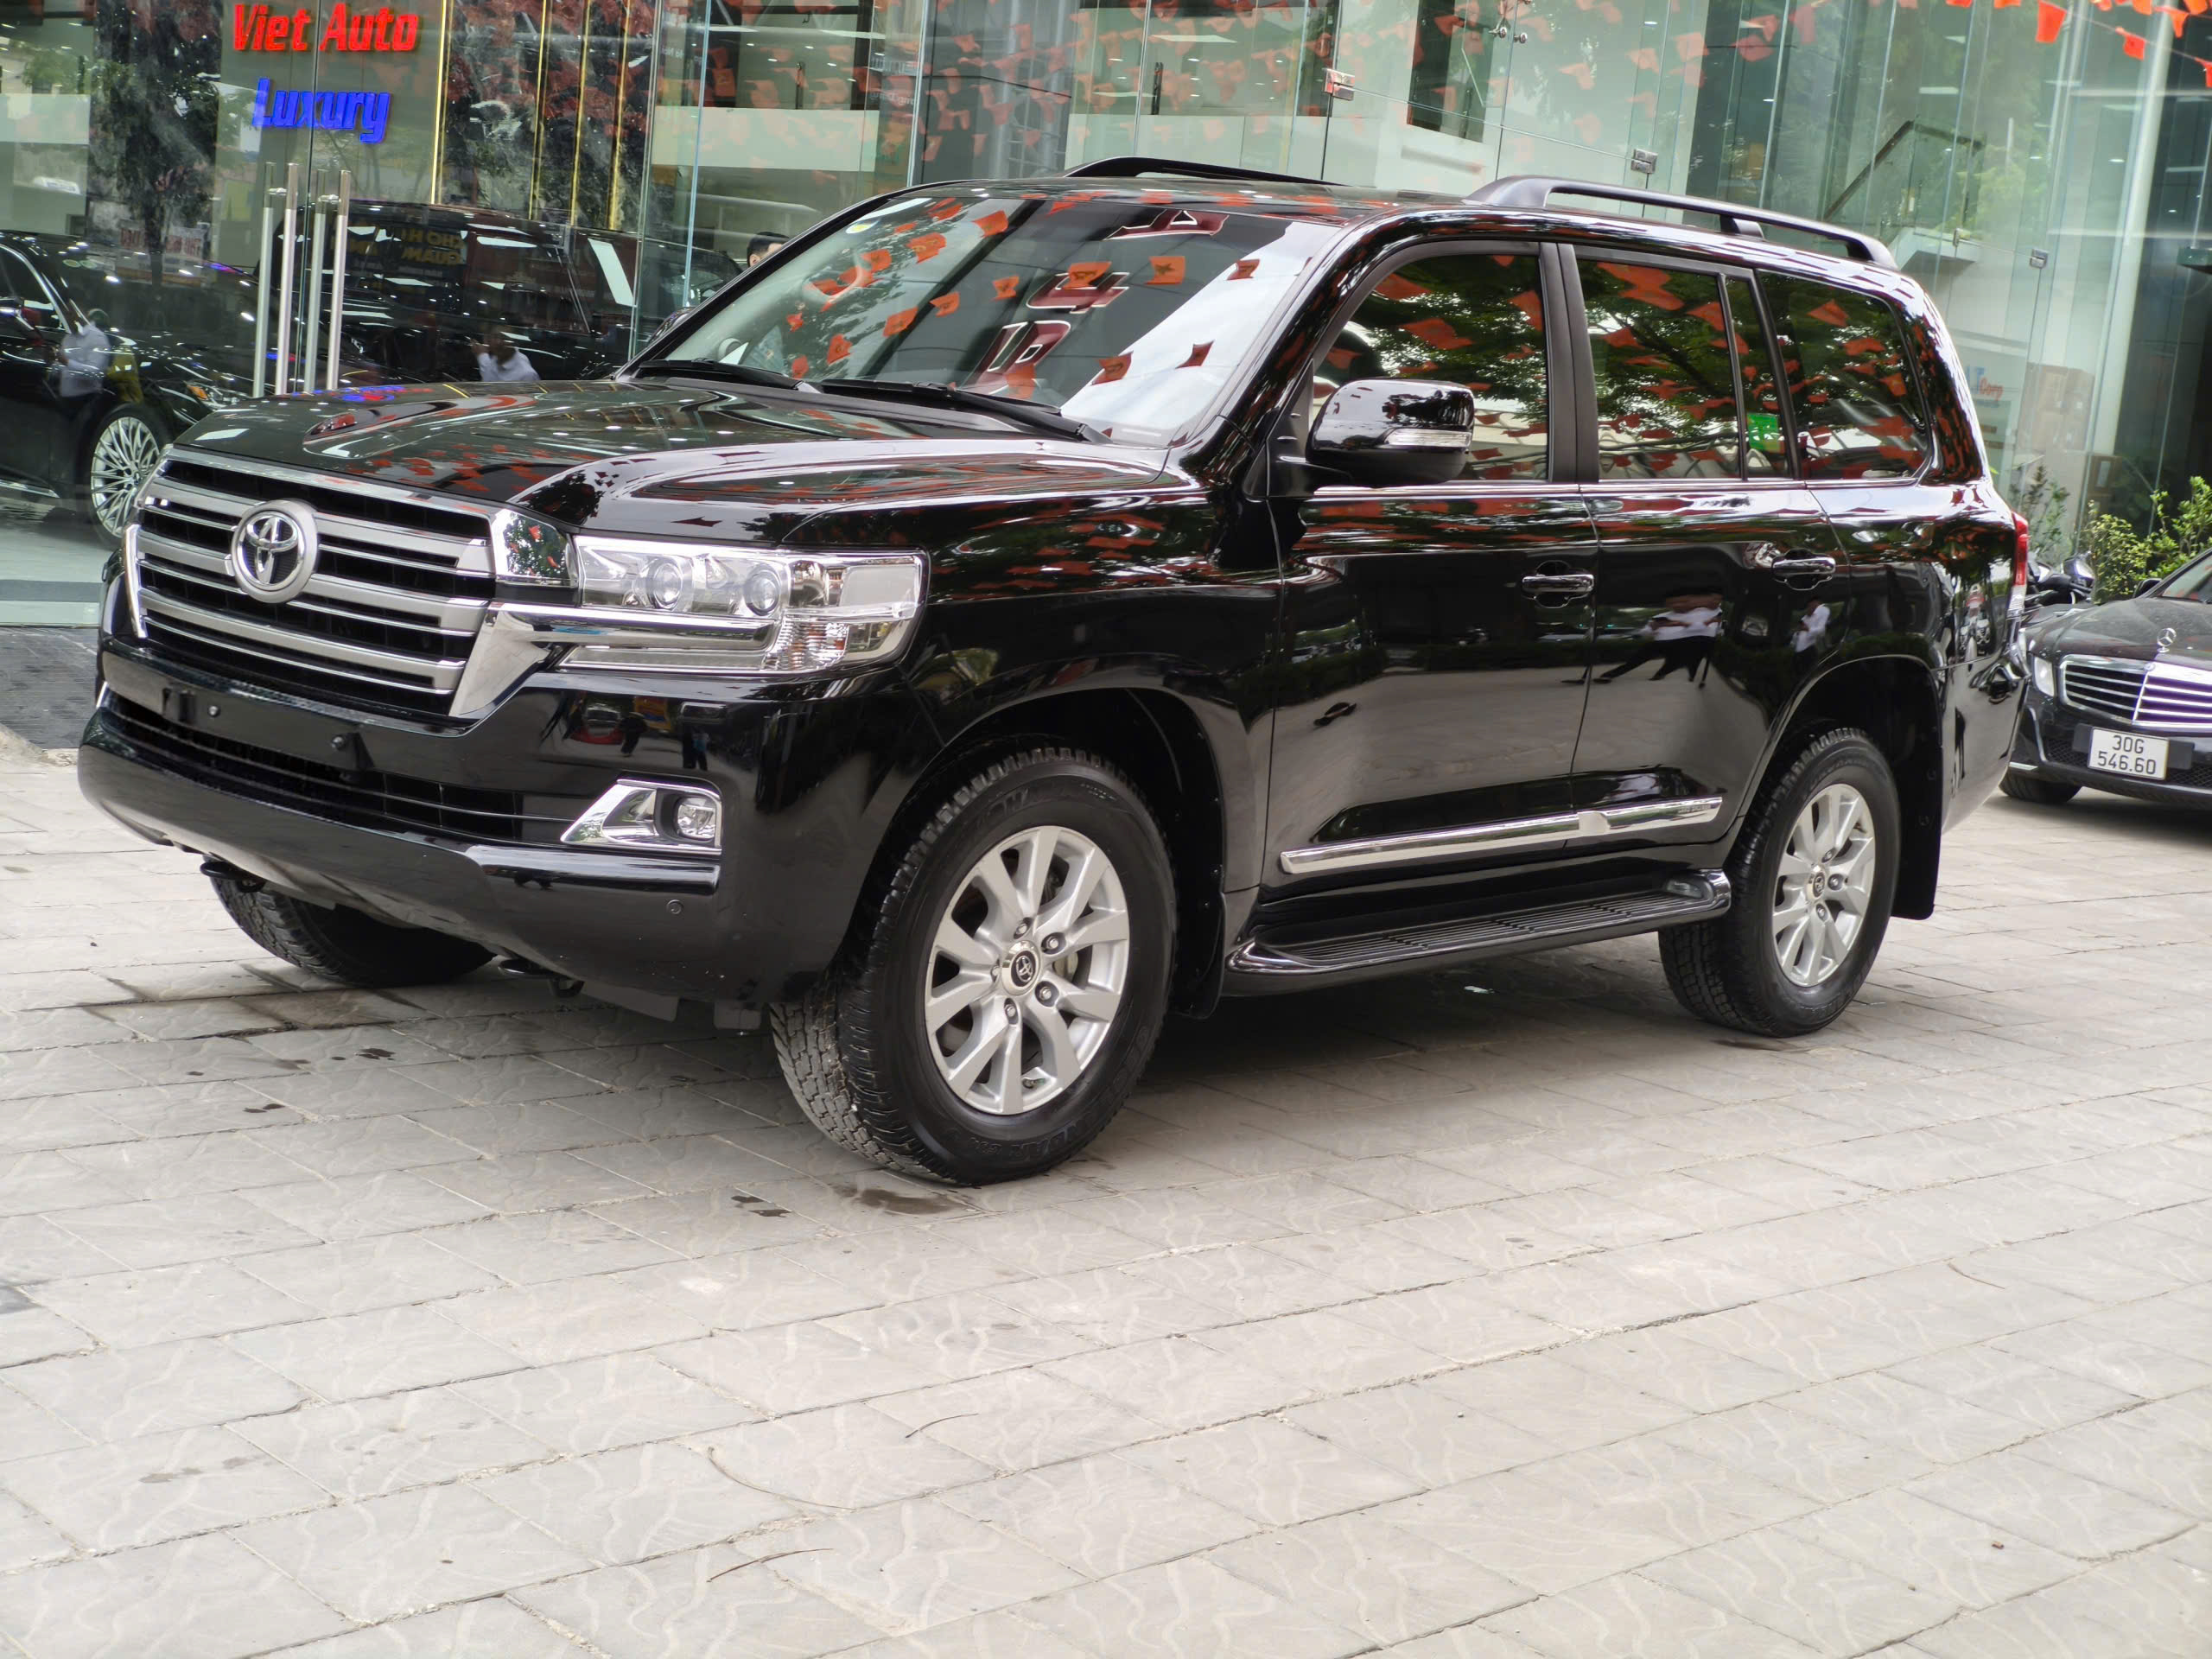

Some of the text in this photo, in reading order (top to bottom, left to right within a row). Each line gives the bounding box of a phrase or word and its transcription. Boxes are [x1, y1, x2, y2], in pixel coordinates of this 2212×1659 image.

[233, 3, 419, 52] Viet Auto
[252, 77, 391, 144] Luxury
[2112, 734, 2145, 754] 30G
[2098, 751, 2157, 775] 546.60
